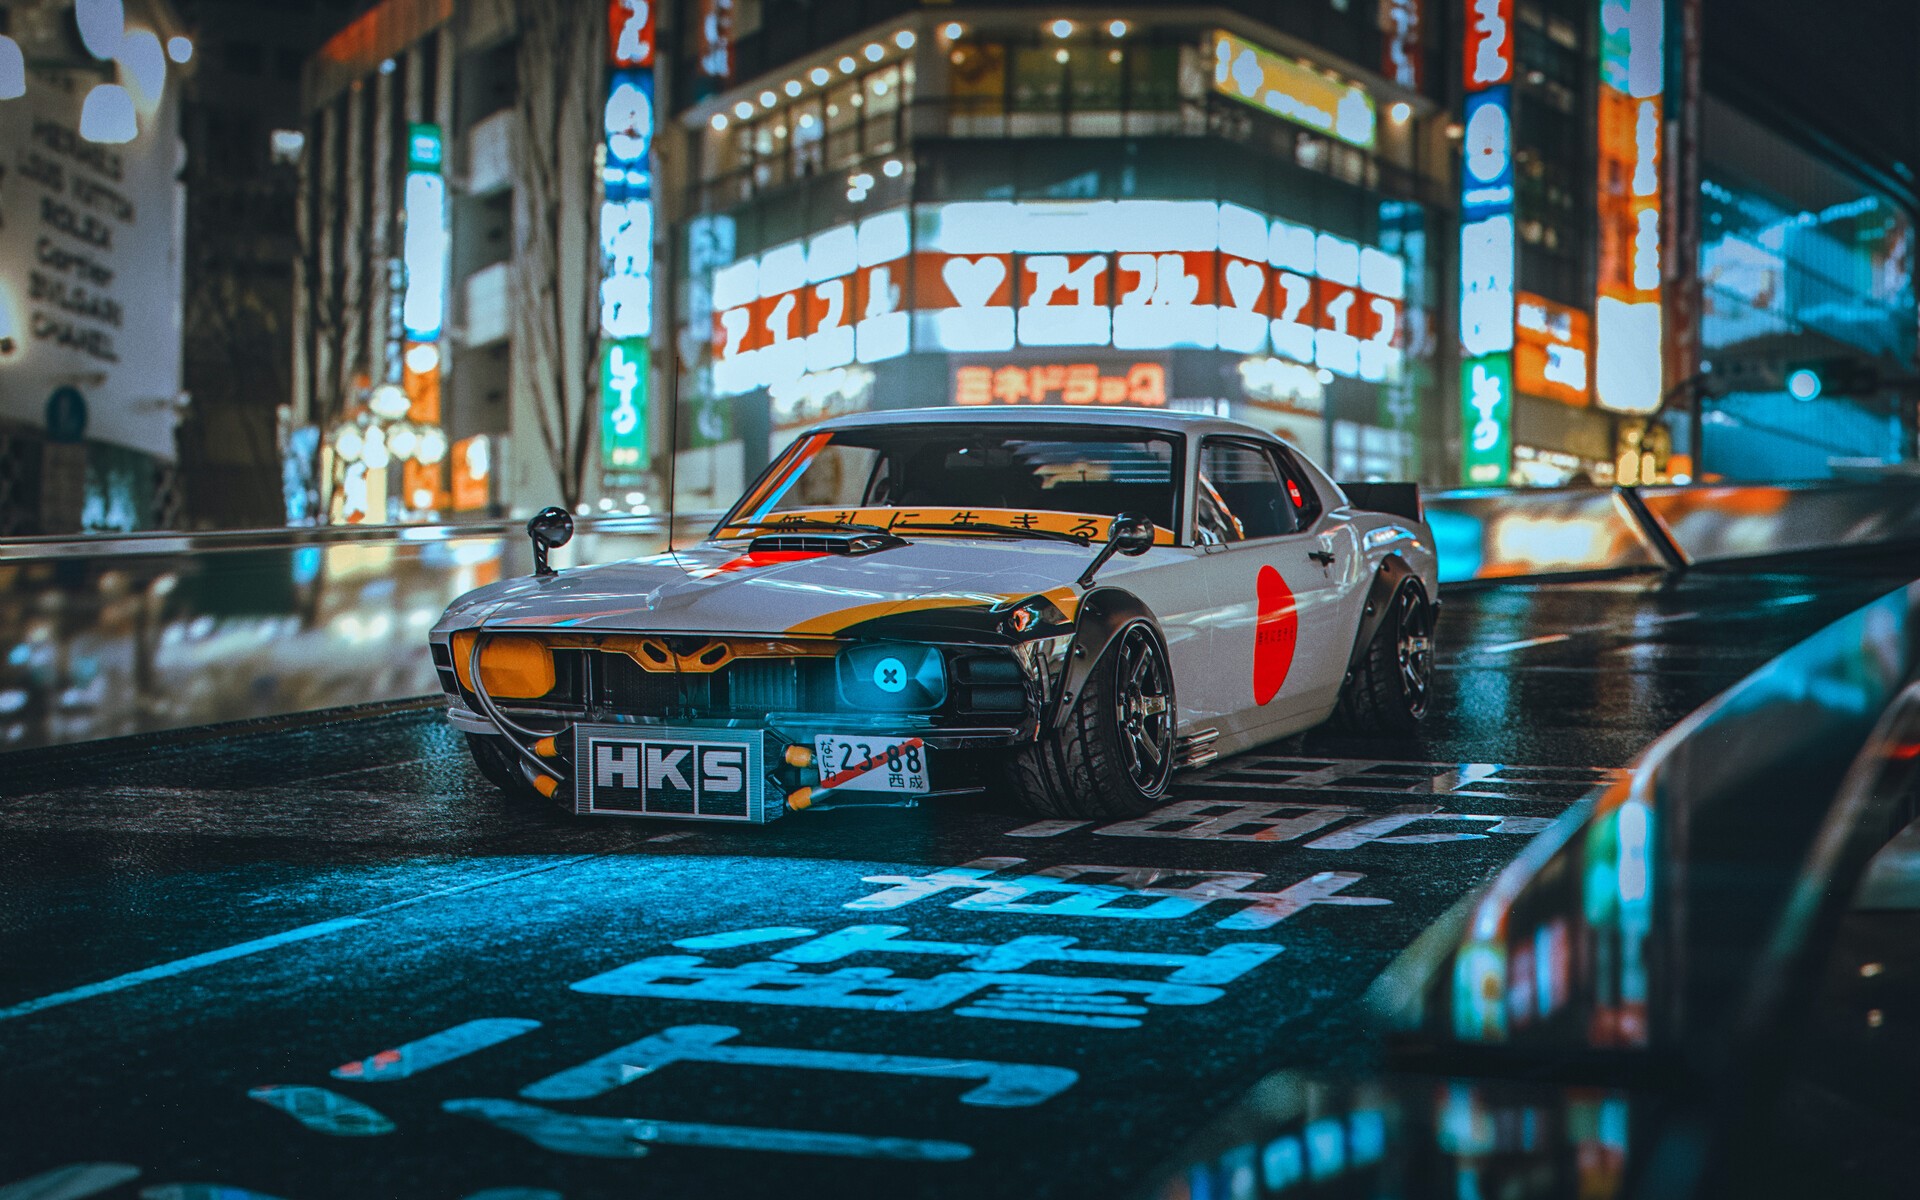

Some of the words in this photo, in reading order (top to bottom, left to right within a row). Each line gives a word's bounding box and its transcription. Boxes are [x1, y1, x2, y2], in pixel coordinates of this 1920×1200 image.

[1278, 271, 1404, 343] アイフ
[597, 746, 742, 793] HKS
[819, 739, 837, 782] なにわ
[838, 743, 922, 774] 23-88
[888, 773, 924, 789] 西成
